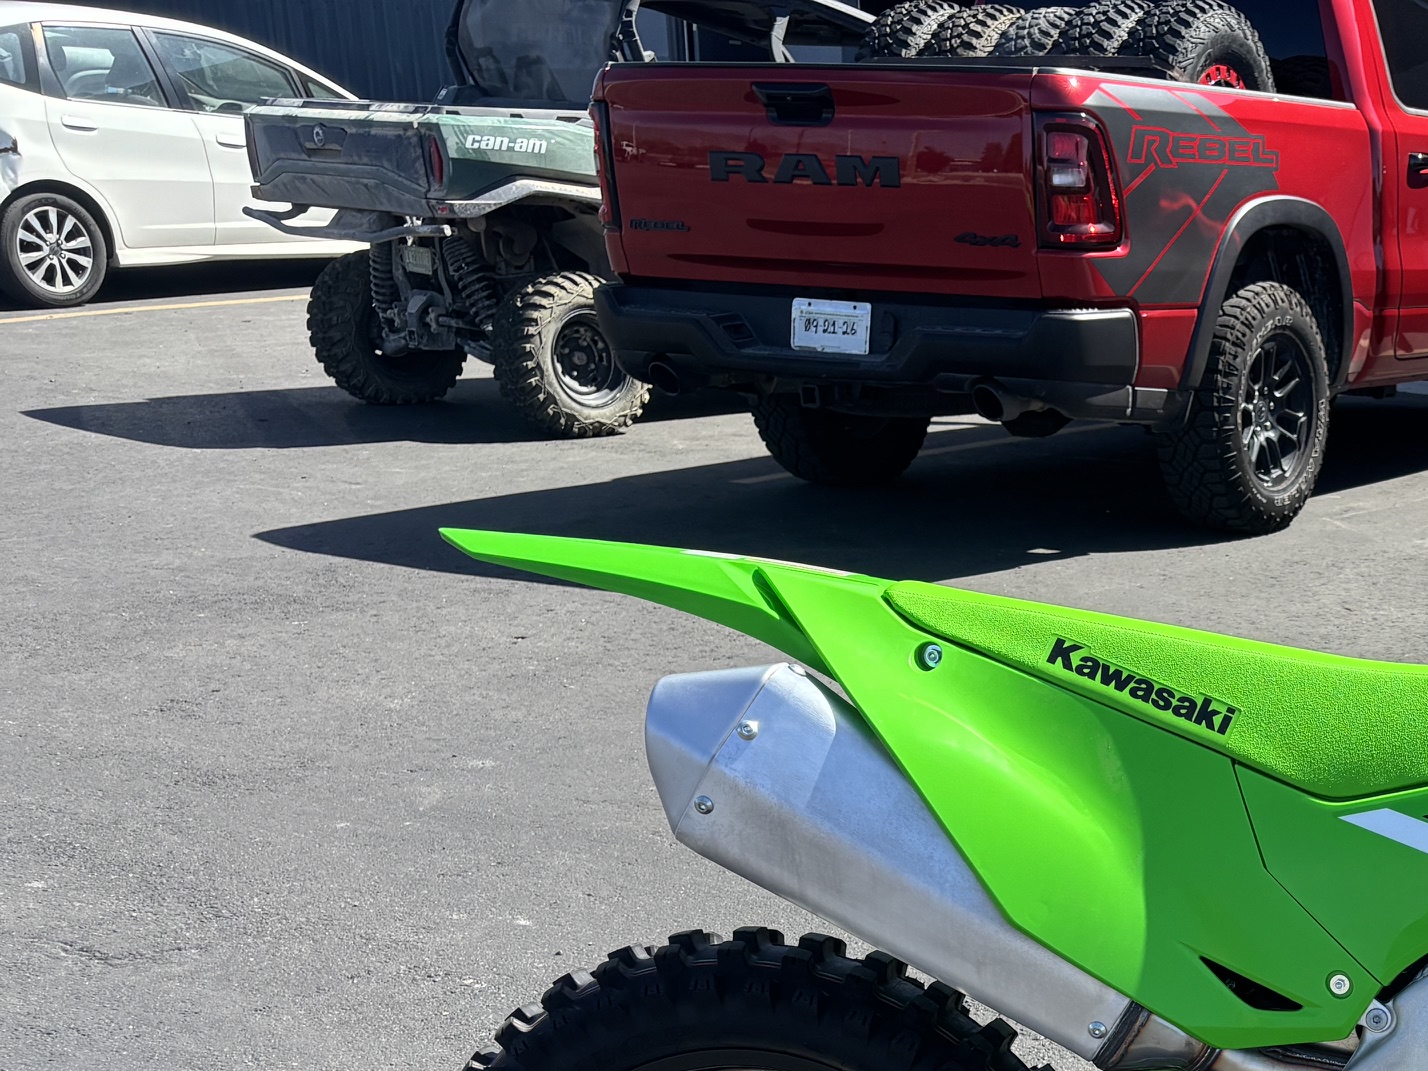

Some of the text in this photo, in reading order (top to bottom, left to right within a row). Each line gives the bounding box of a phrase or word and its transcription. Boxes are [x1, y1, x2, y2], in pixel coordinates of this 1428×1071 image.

[465, 134, 548, 154] can-am
[1127, 125, 1280, 169] REBEL
[708, 150, 901, 188] RAM
[629, 218, 691, 232] REBEL
[953, 231, 1022, 248] 4x4
[1046, 636, 1238, 737] Kawasaki
